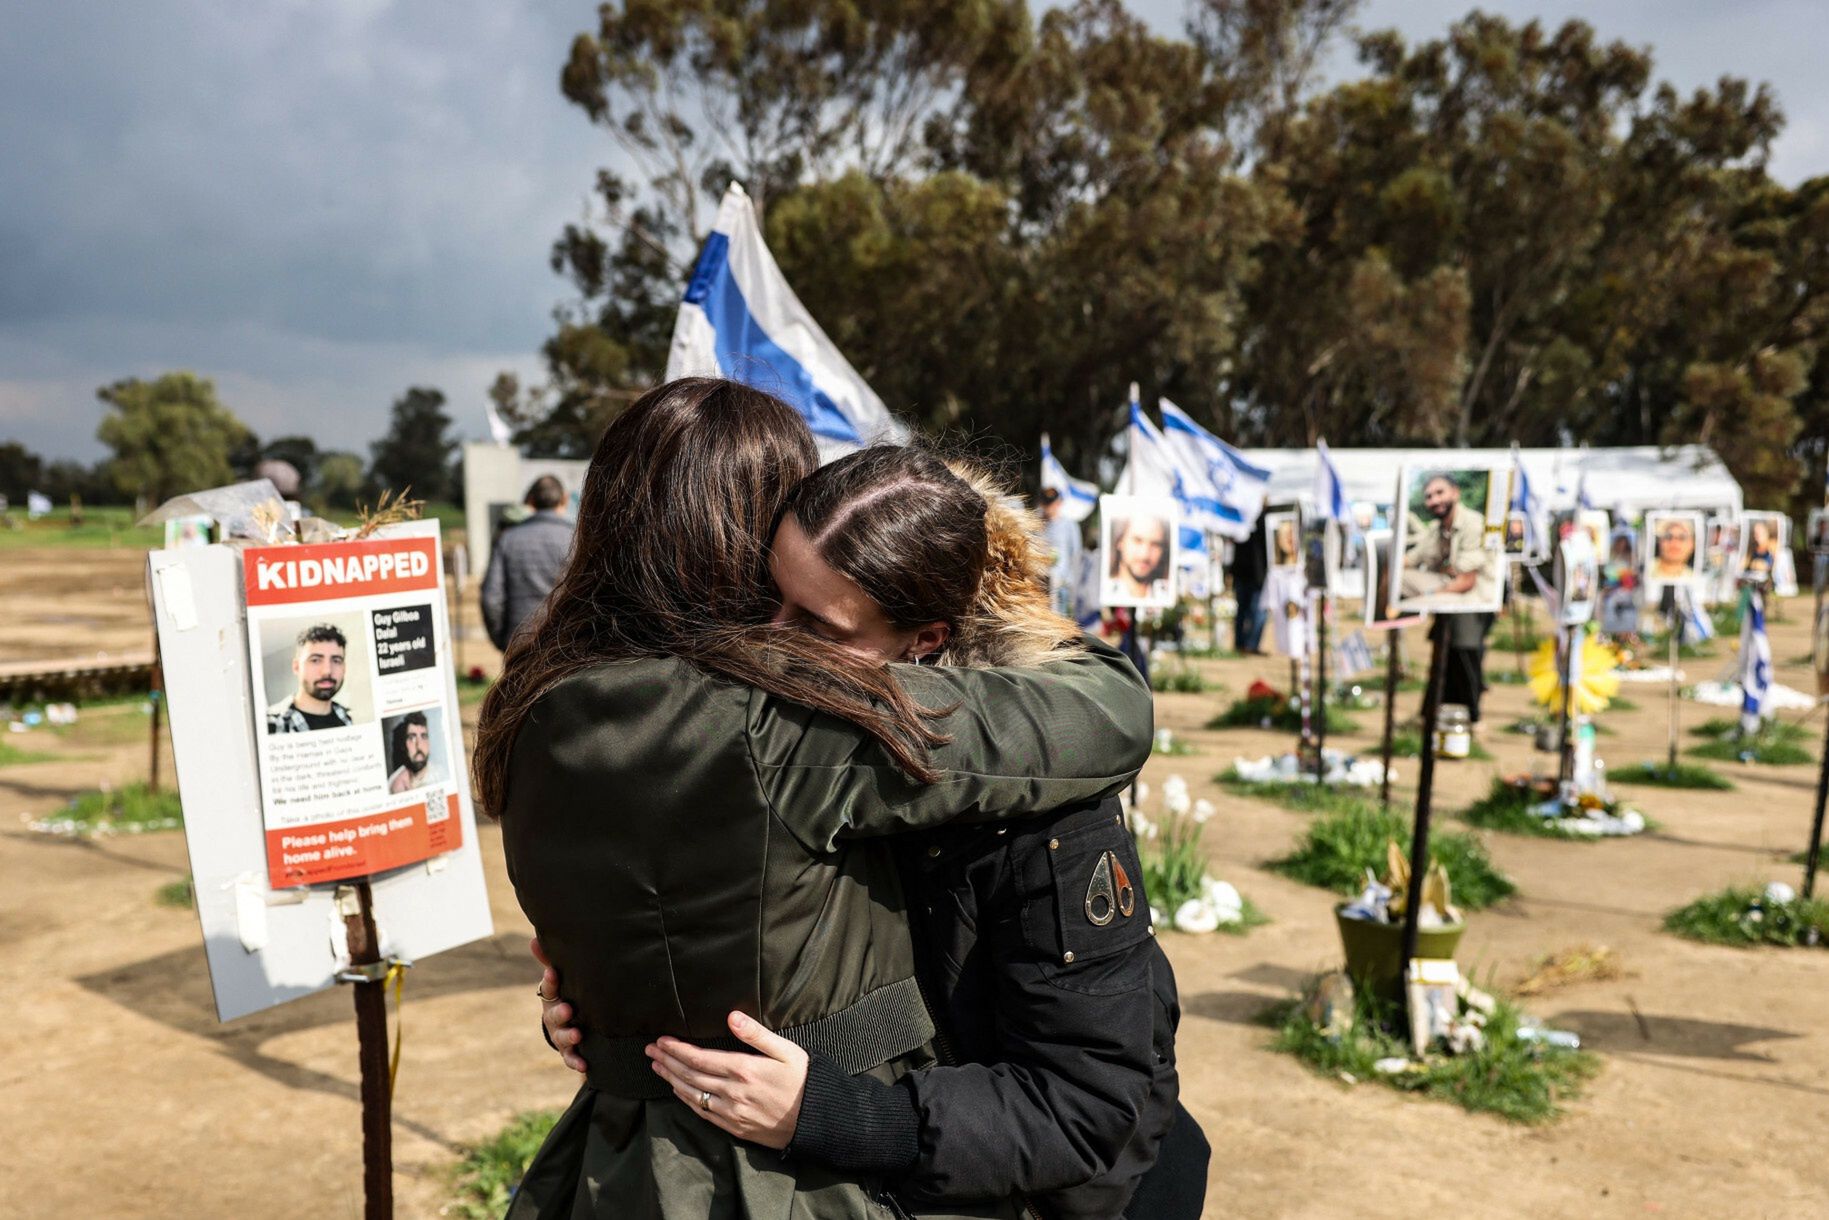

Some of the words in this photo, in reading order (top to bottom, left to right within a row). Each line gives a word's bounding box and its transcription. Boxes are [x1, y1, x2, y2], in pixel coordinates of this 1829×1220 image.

[257, 551, 428, 590] KIDNAPPED
[374, 613, 392, 626] Guy
[377, 642, 389, 655] 22
[389, 640, 412, 655] years
[412, 636, 427, 650] old
[290, 794, 311, 803] need
[313, 791, 329, 799] him
[332, 789, 351, 798] back
[282, 834, 326, 849] Please
[328, 829, 357, 842] help
[358, 823, 388, 838] bring
[389, 816, 414, 831] them
[283, 851, 321, 865] home
[323, 846, 357, 859] alive.
